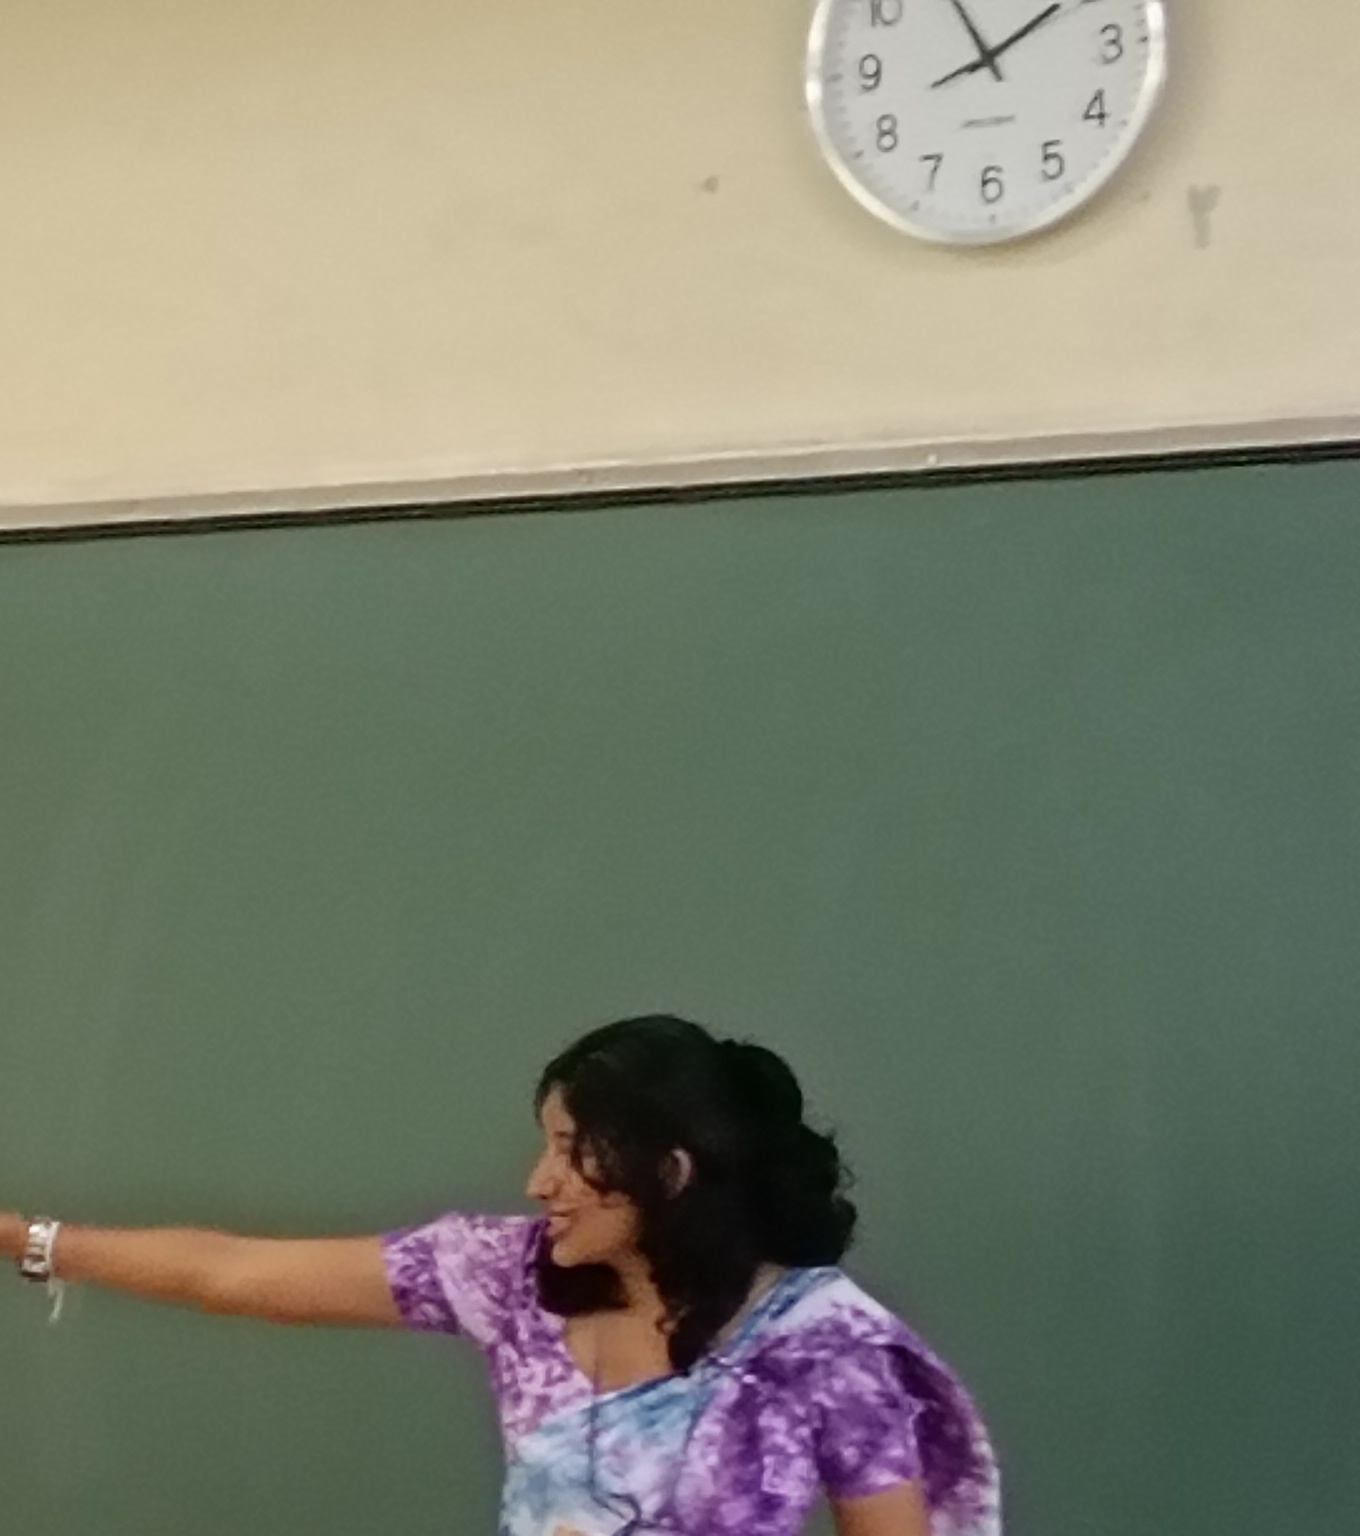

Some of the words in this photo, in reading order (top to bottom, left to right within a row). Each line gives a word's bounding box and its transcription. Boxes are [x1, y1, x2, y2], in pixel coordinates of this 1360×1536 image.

[1098, 23, 1124, 65] 3
[857, 53, 882, 91] 9
[1083, 88, 1110, 128] 4
[876, 113, 899, 152] 8
[920, 153, 944, 191] 7
[1041, 139, 1065, 181] 5
[981, 166, 1004, 203] 6
